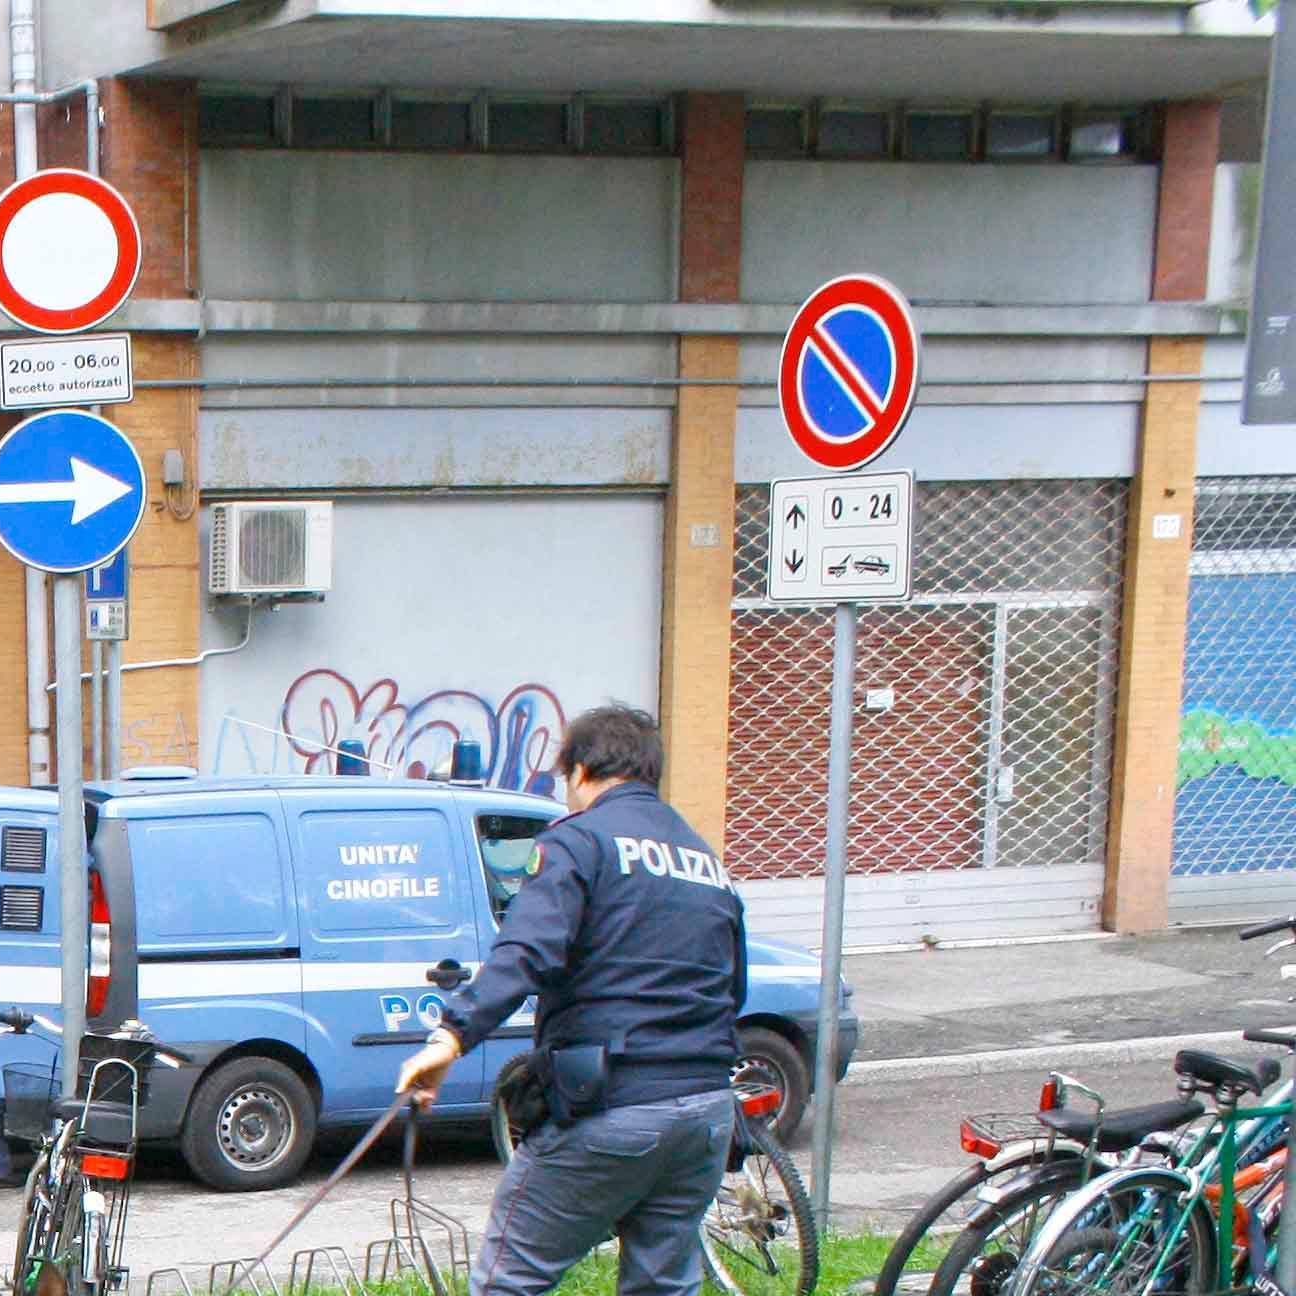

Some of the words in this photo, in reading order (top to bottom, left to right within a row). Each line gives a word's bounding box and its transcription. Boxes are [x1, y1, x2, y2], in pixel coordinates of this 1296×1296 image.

[8, 380, 55, 395] eccetto
[58, 375, 123, 392] autorizzati
[831, 495, 843, 520] 0
[869, 492, 892, 519] 24
[339, 843, 419, 866] UNITA'
[614, 836, 737, 895] POLIZIA
[326, 876, 441, 900] CINOFILE
